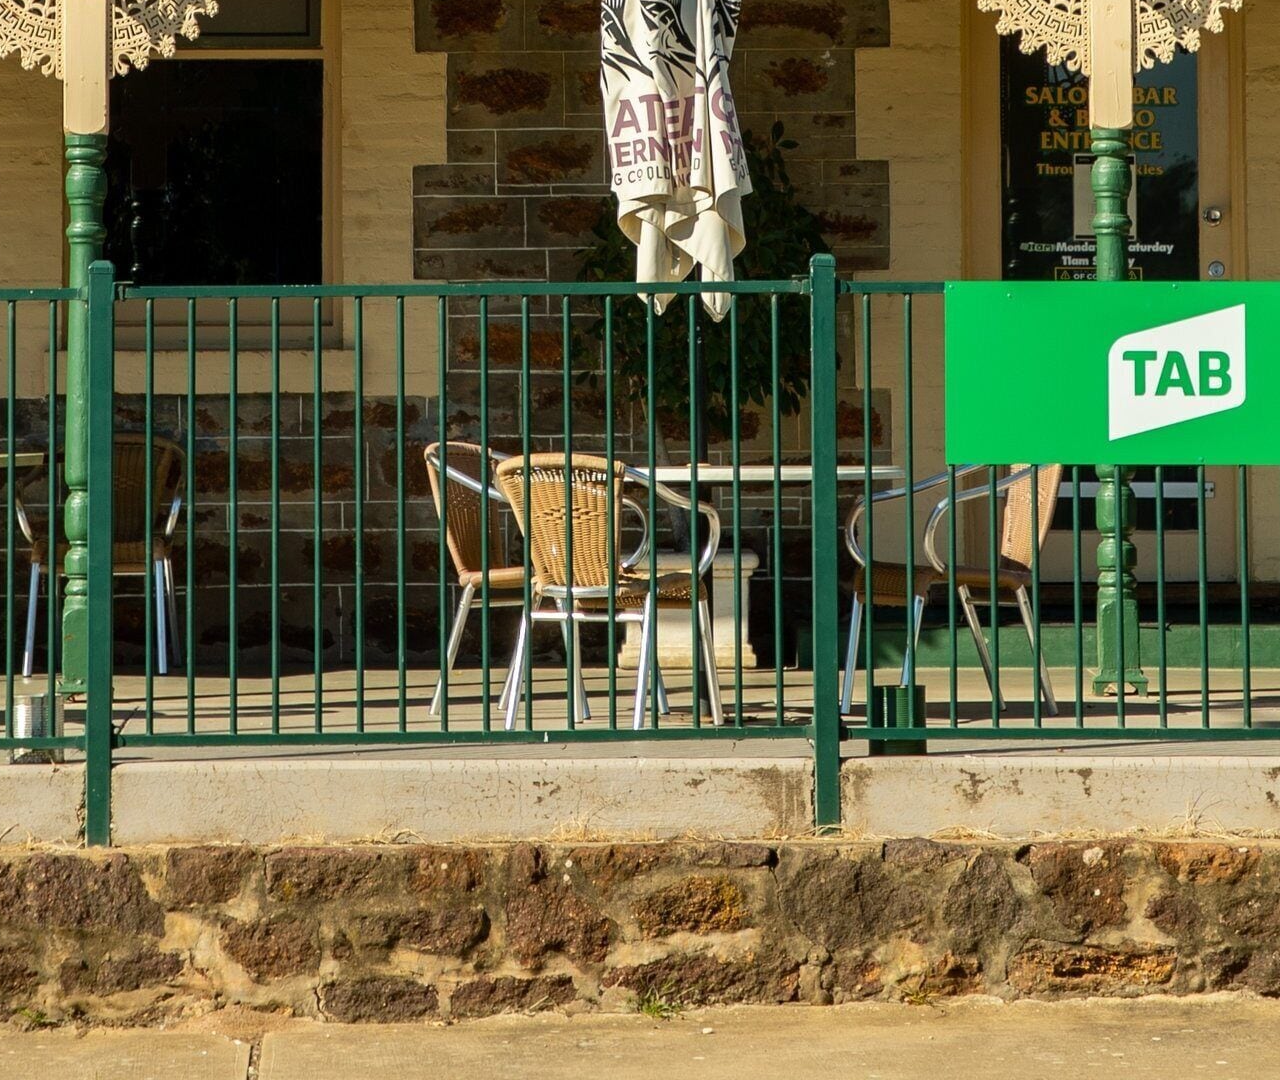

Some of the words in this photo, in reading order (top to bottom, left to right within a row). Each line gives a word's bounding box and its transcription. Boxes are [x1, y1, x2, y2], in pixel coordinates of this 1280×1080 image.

[1025, 86, 1089, 105] SALO
[1132, 86, 1178, 105] BAR
[1048, 109, 1069, 127] &
[1040, 131, 1163, 150] ENTCE
[1036, 163, 1074, 175] Throu
[1137, 163, 1165, 175] kies
[1056, 241, 1097, 252] Monda
[1128, 241, 1174, 255] aturday
[1122, 350, 1233, 397] TAB
